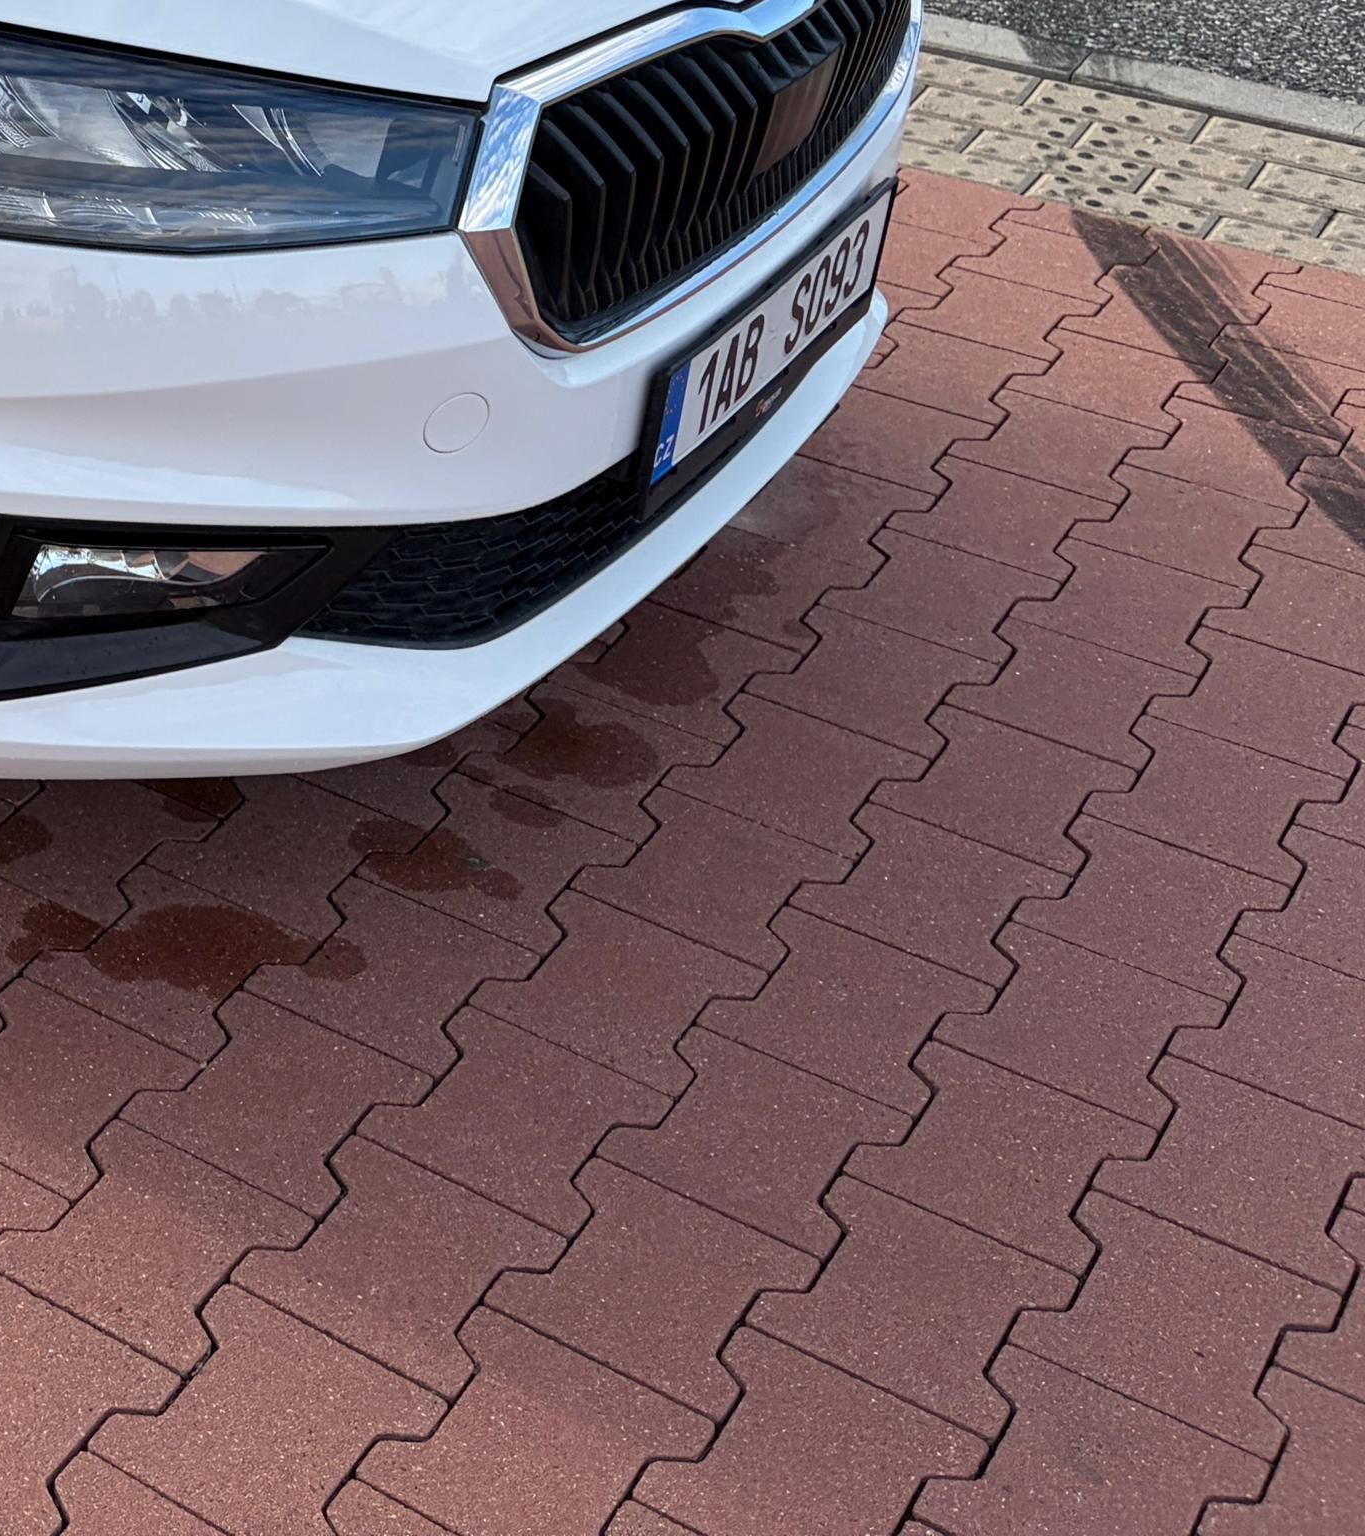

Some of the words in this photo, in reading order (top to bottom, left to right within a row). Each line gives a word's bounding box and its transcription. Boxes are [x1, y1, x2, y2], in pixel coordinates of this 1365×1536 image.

[697, 313, 766, 436] 1AB
[784, 218, 870, 355] S093
[653, 433, 675, 468] CZ
